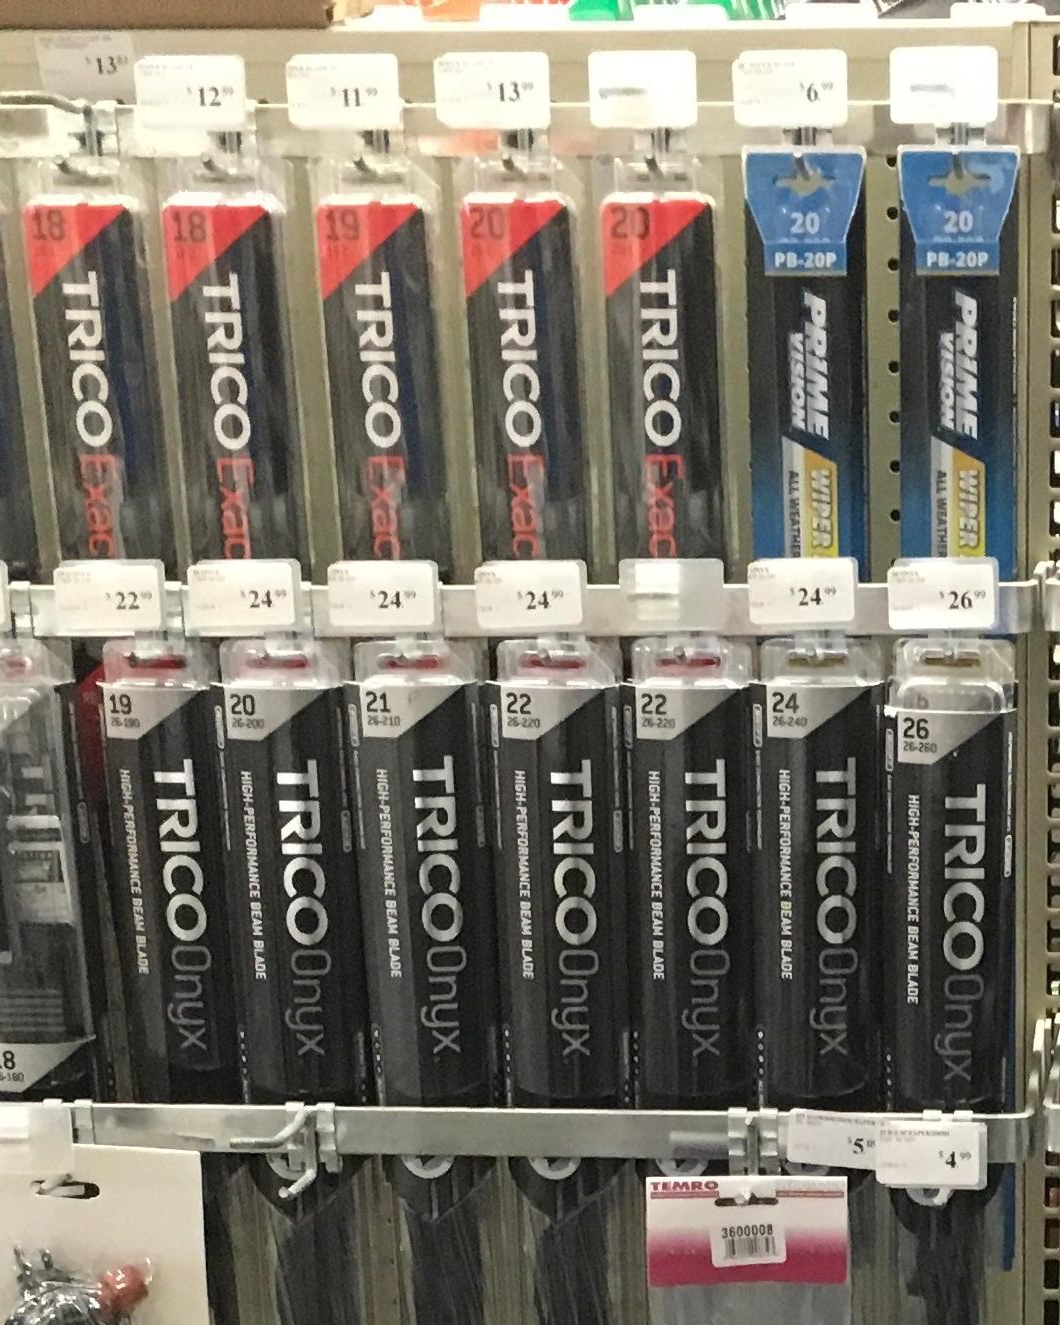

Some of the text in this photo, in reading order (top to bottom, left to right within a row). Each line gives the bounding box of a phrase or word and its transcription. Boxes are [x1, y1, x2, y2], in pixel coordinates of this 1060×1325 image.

[32, 209, 66, 241] 18
[173, 209, 208, 242] 18
[325, 209, 359, 241] 19
[470, 208, 505, 239] 20
[774, 251, 836, 268] PB-20P
[790, 213, 820, 234] 20
[926, 251, 988, 268] PB-20P
[944, 211, 974, 233] 20
[62, 271, 112, 447] TRICO
[202, 272, 251, 450] TRICO
[355, 272, 401, 447] TRICO
[497, 270, 541, 447] TRICO
[640, 270, 682, 447] TRICO
[788, 332, 807, 430] VISION
[803, 287, 829, 439] PRIME
[940, 331, 955, 429] VISION
[954, 289, 978, 439] PRIME
[789, 501, 802, 557] WEATHE
[811, 468, 835, 549] WIPER
[937, 501, 949, 557] WEATHE
[958, 469, 978, 548] WIPER
[109, 694, 132, 715] 19
[230, 694, 256, 716] 20
[365, 691, 391, 713] 21
[506, 692, 532, 715] 22
[641, 693, 667, 715] 22
[772, 691, 800, 714] 24
[902, 717, 930, 740] 26
[120, 769, 150, 975] HIGH-PERFORMANCE BEAM BLADE
[153, 758, 212, 1051] TRICO Onyx
[241, 770, 267, 980] HIGH-PERFORMANCE BEAM BLADE
[276, 759, 332, 1056] TRICO Onyx
[376, 769, 402, 978] HIGH-PERFORMANCE BEAM BLADE
[412, 755, 467, 1054] TRICO Onyx
[514, 770, 535, 980] HIGH-PERFORMANCE BEAM BLADE
[550, 758, 599, 1057] TRICO Onyx
[648, 770, 665, 980] HIGH-PERFORMANCE BEAM BLADE
[681, 758, 731, 1057] TRICO Onyx
[778, 769, 793, 980] HIGH-PERFORMANCE BEAM BLADE
[809, 757, 859, 1056] TRICO Onyx
[907, 794, 920, 1004] HIGH-PERFORMANCE BEAM BLADE
[934, 783, 986, 1081] TRICO Onyx
[650, 1180, 719, 1192] TEMRO
[721, 1223, 774, 1239] 3600008
